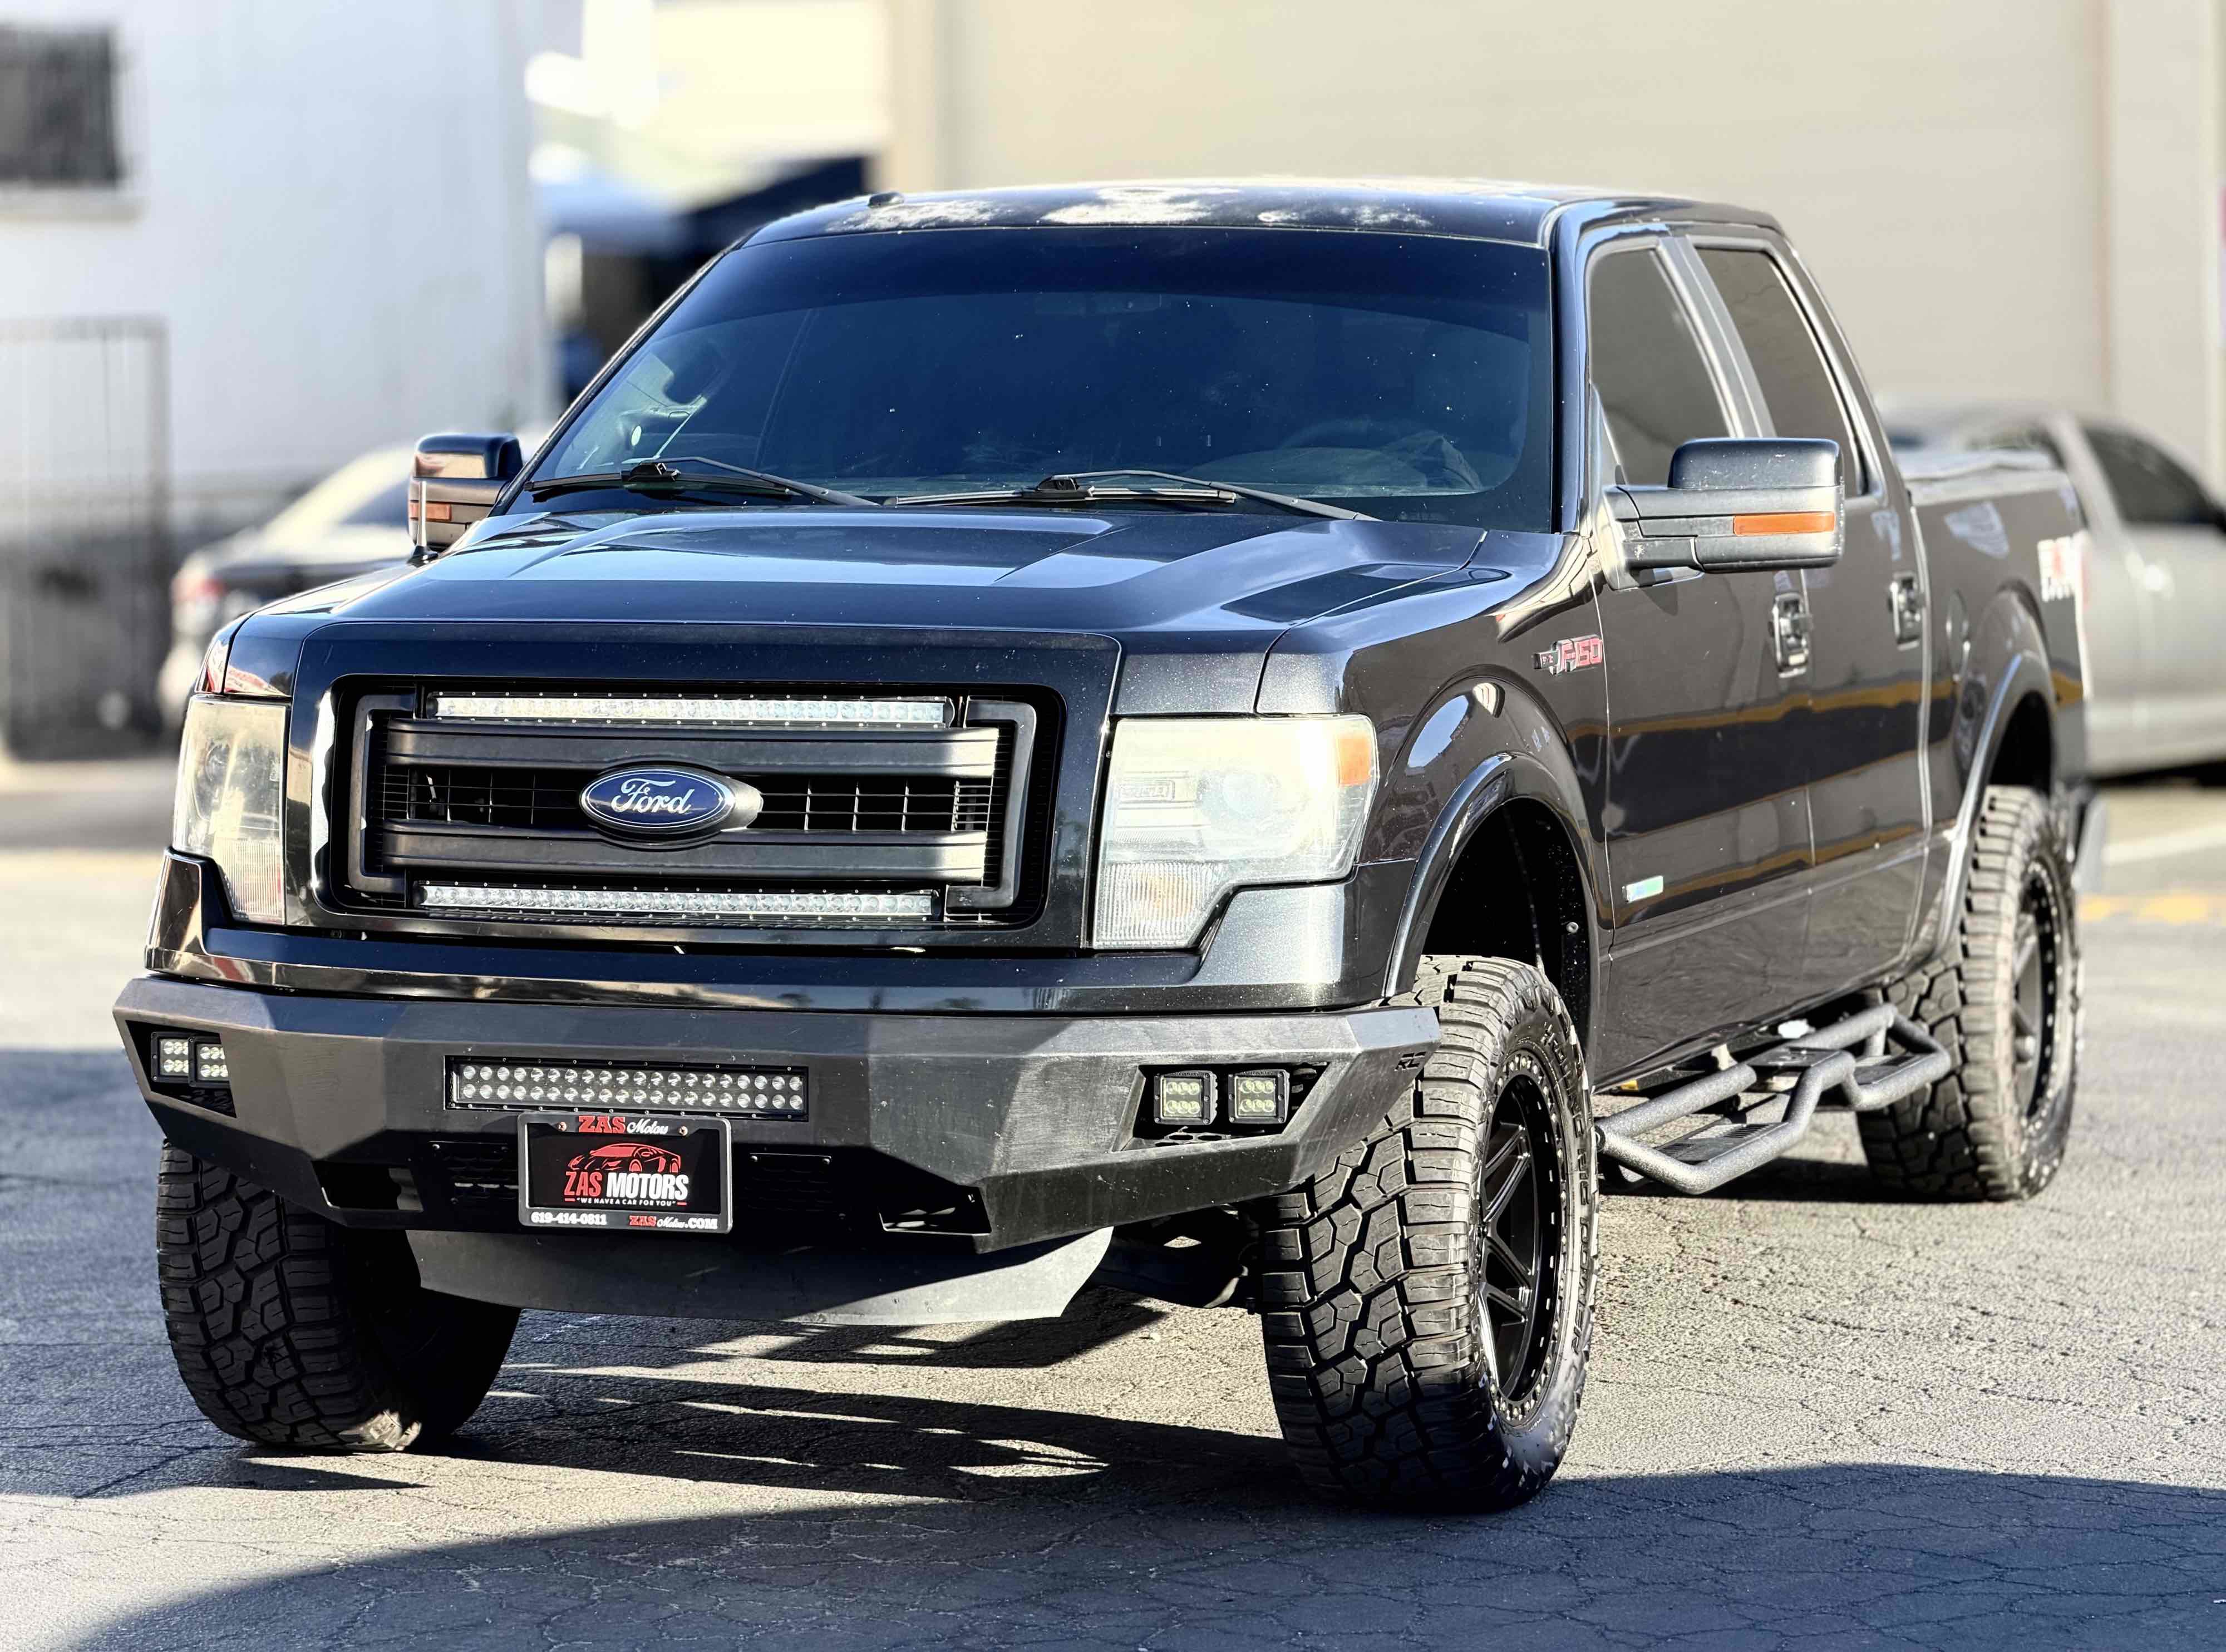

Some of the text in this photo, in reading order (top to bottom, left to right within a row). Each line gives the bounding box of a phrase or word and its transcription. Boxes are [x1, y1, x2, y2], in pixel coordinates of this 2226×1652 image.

[1558, 638, 1603, 672] F-150
[612, 778, 695, 813] Ford
[578, 1116, 626, 1133] ZAS
[564, 1171, 689, 1201] ZAS MOTORS
[531, 1211, 607, 1225] 619-414-0811
